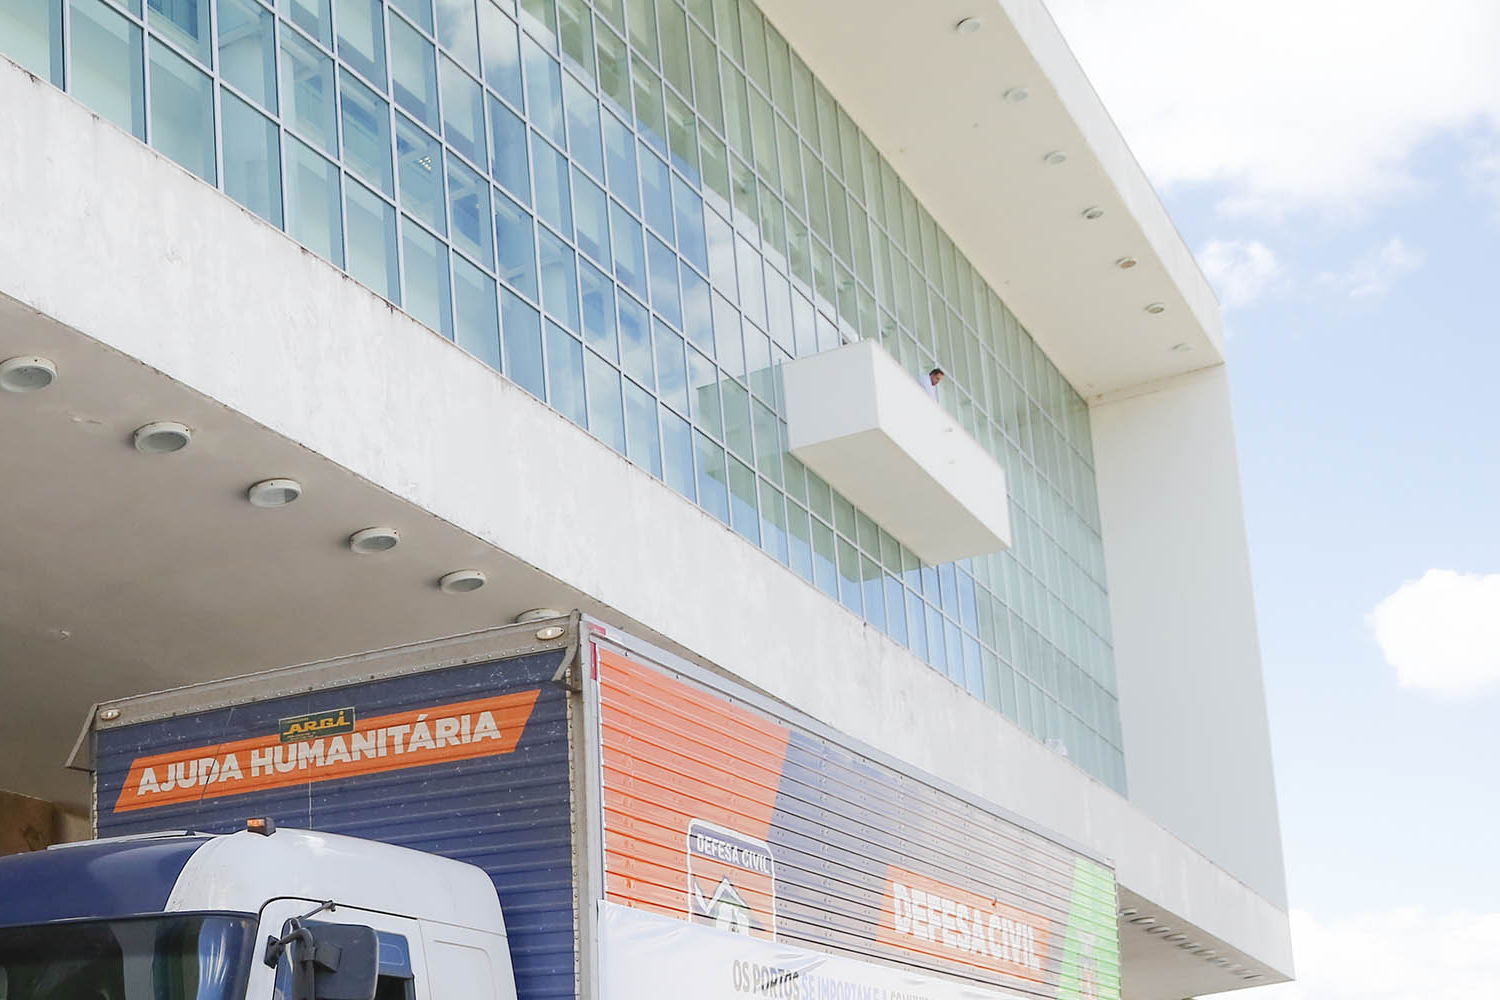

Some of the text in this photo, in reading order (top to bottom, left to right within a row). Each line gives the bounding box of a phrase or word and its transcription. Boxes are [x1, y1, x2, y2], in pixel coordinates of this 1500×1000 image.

[137, 711, 503, 796] AJUDA HUMANITÁRIA
[696, 833, 771, 874] DEFESA CIVIL
[893, 882, 1041, 971] DEFESA CIVIL
[732, 960, 750, 993] OS
